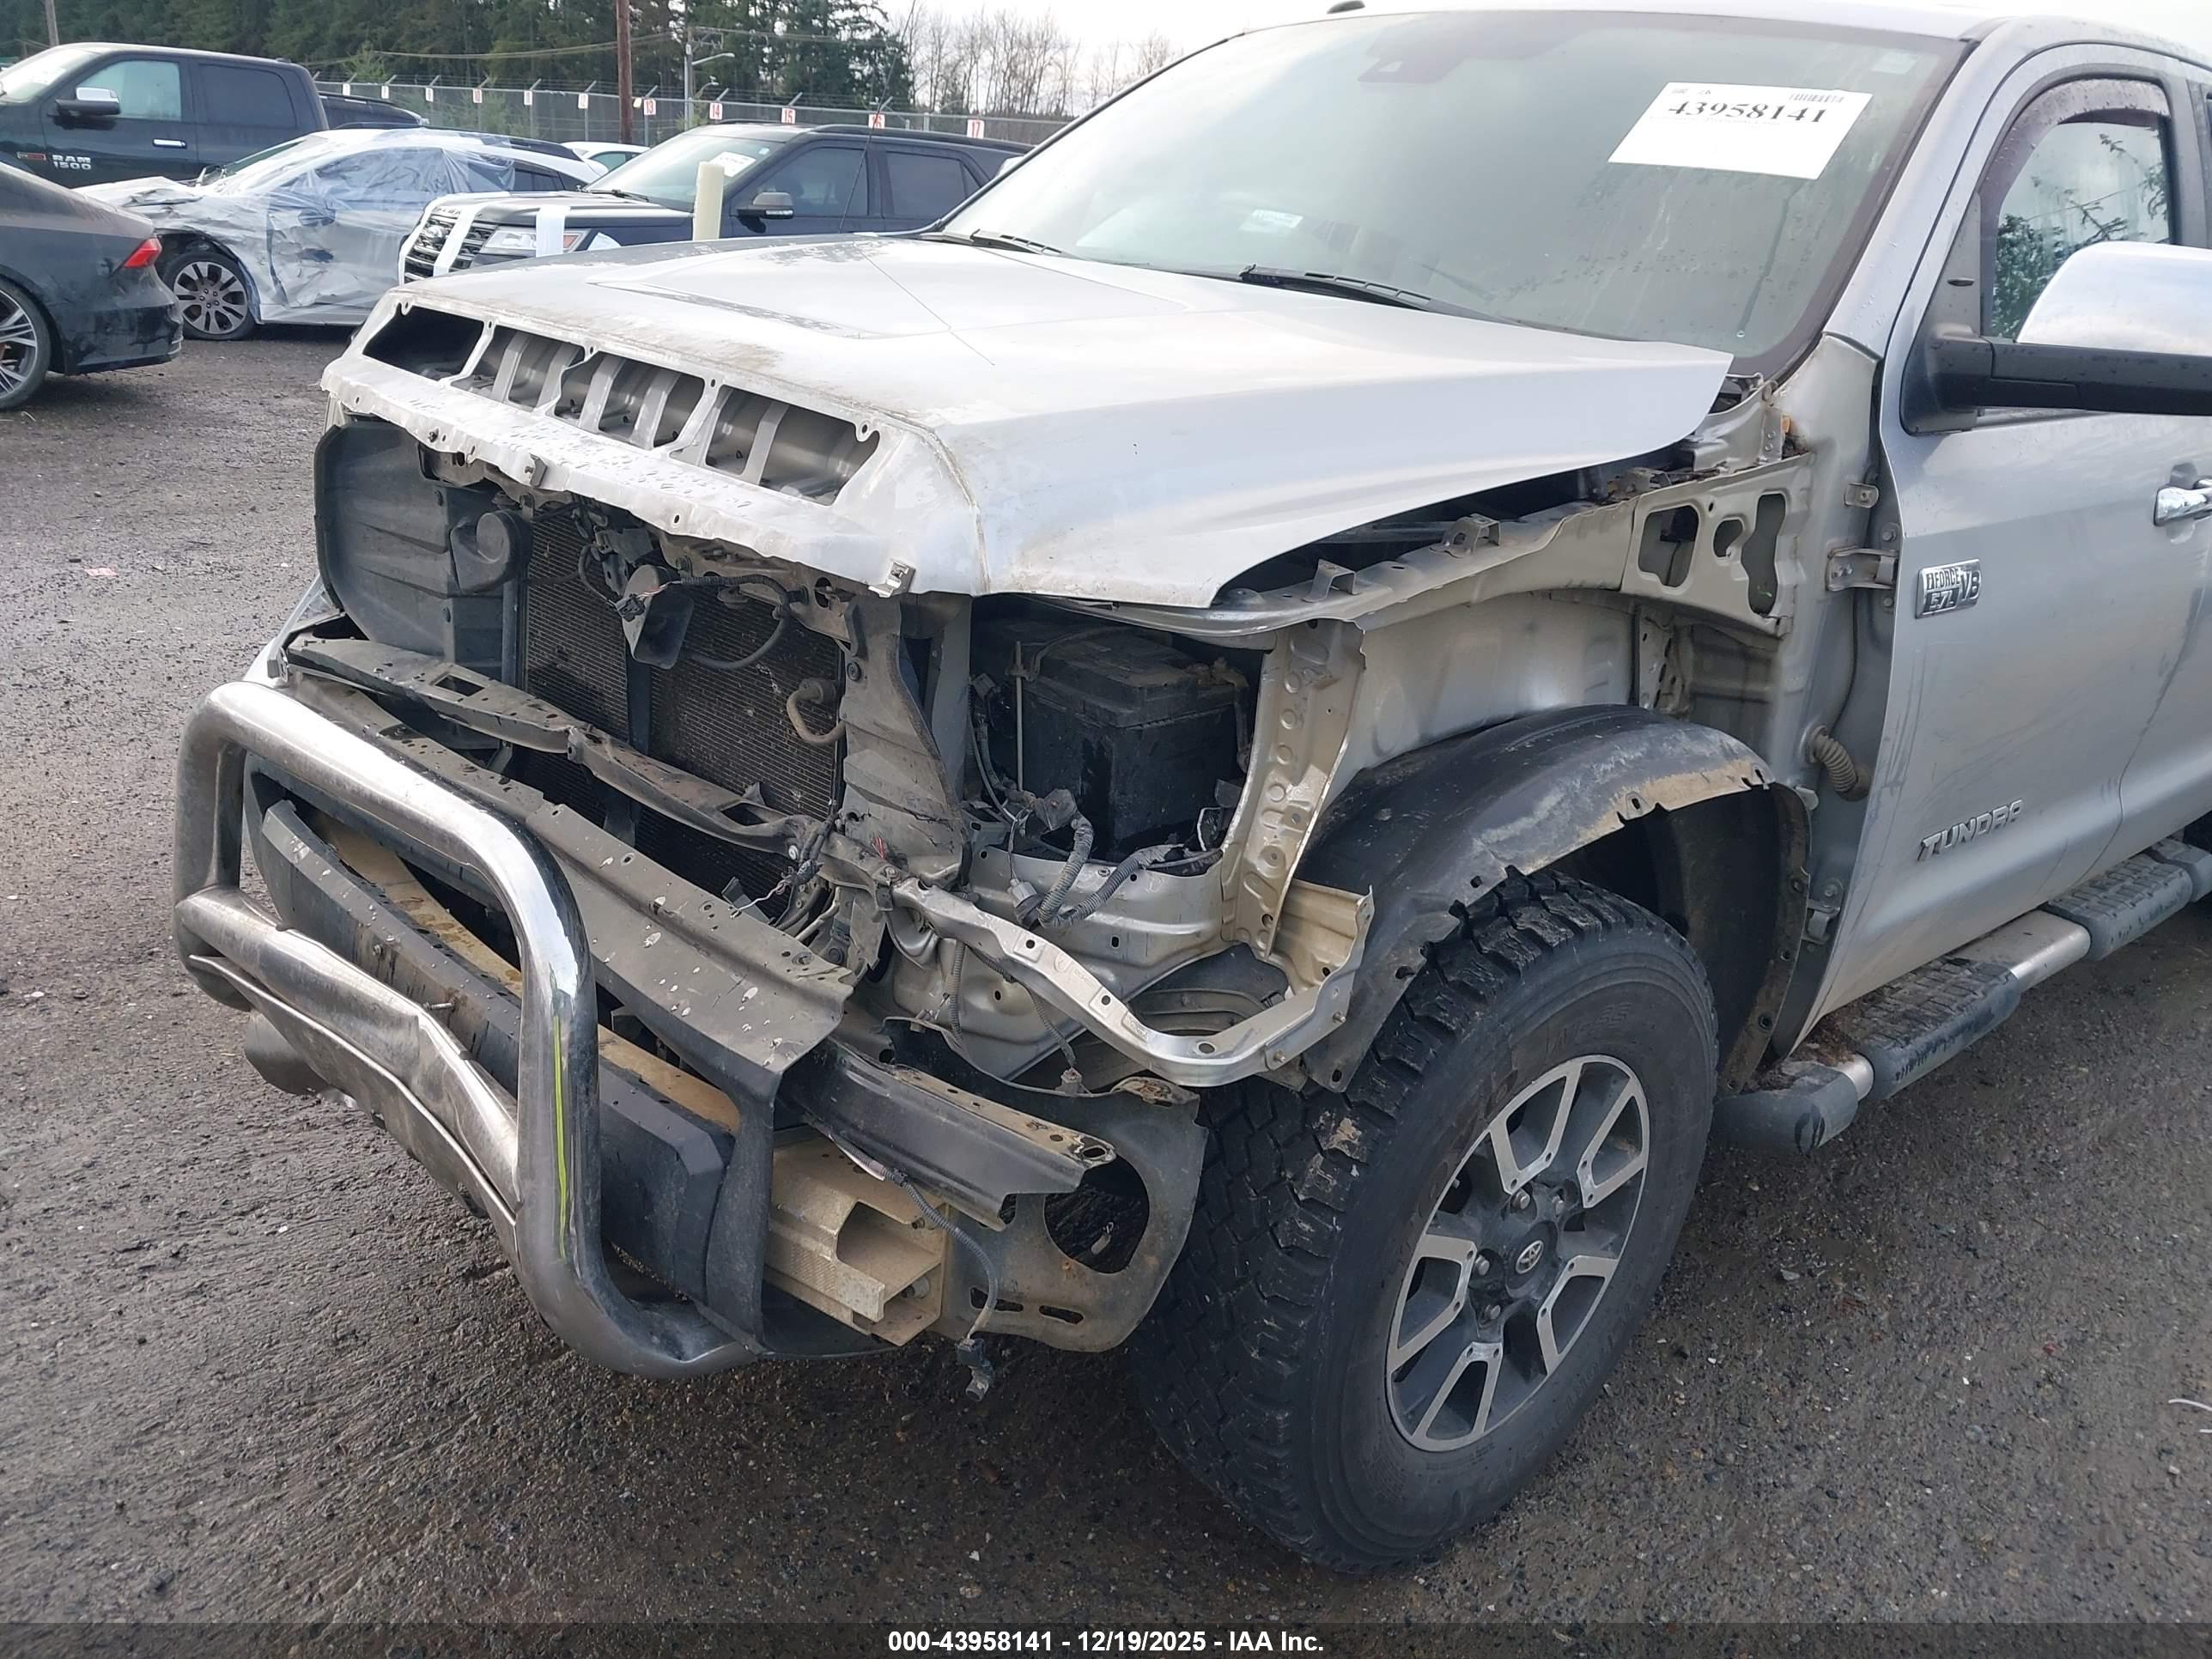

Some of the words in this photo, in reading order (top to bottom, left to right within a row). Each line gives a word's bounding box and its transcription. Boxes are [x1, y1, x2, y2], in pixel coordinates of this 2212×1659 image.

[646, 100, 653, 113] 13
[712, 103, 720, 118] 14
[1668, 100, 1827, 123] 43958141
[784, 109, 793, 124] 15
[972, 121, 981, 137] 17
[52, 155, 91, 163] RAM
[53, 161, 91, 170] 1500
[1960, 569, 1981, 602] V8
[1917, 798, 2023, 860] TUNDRA
